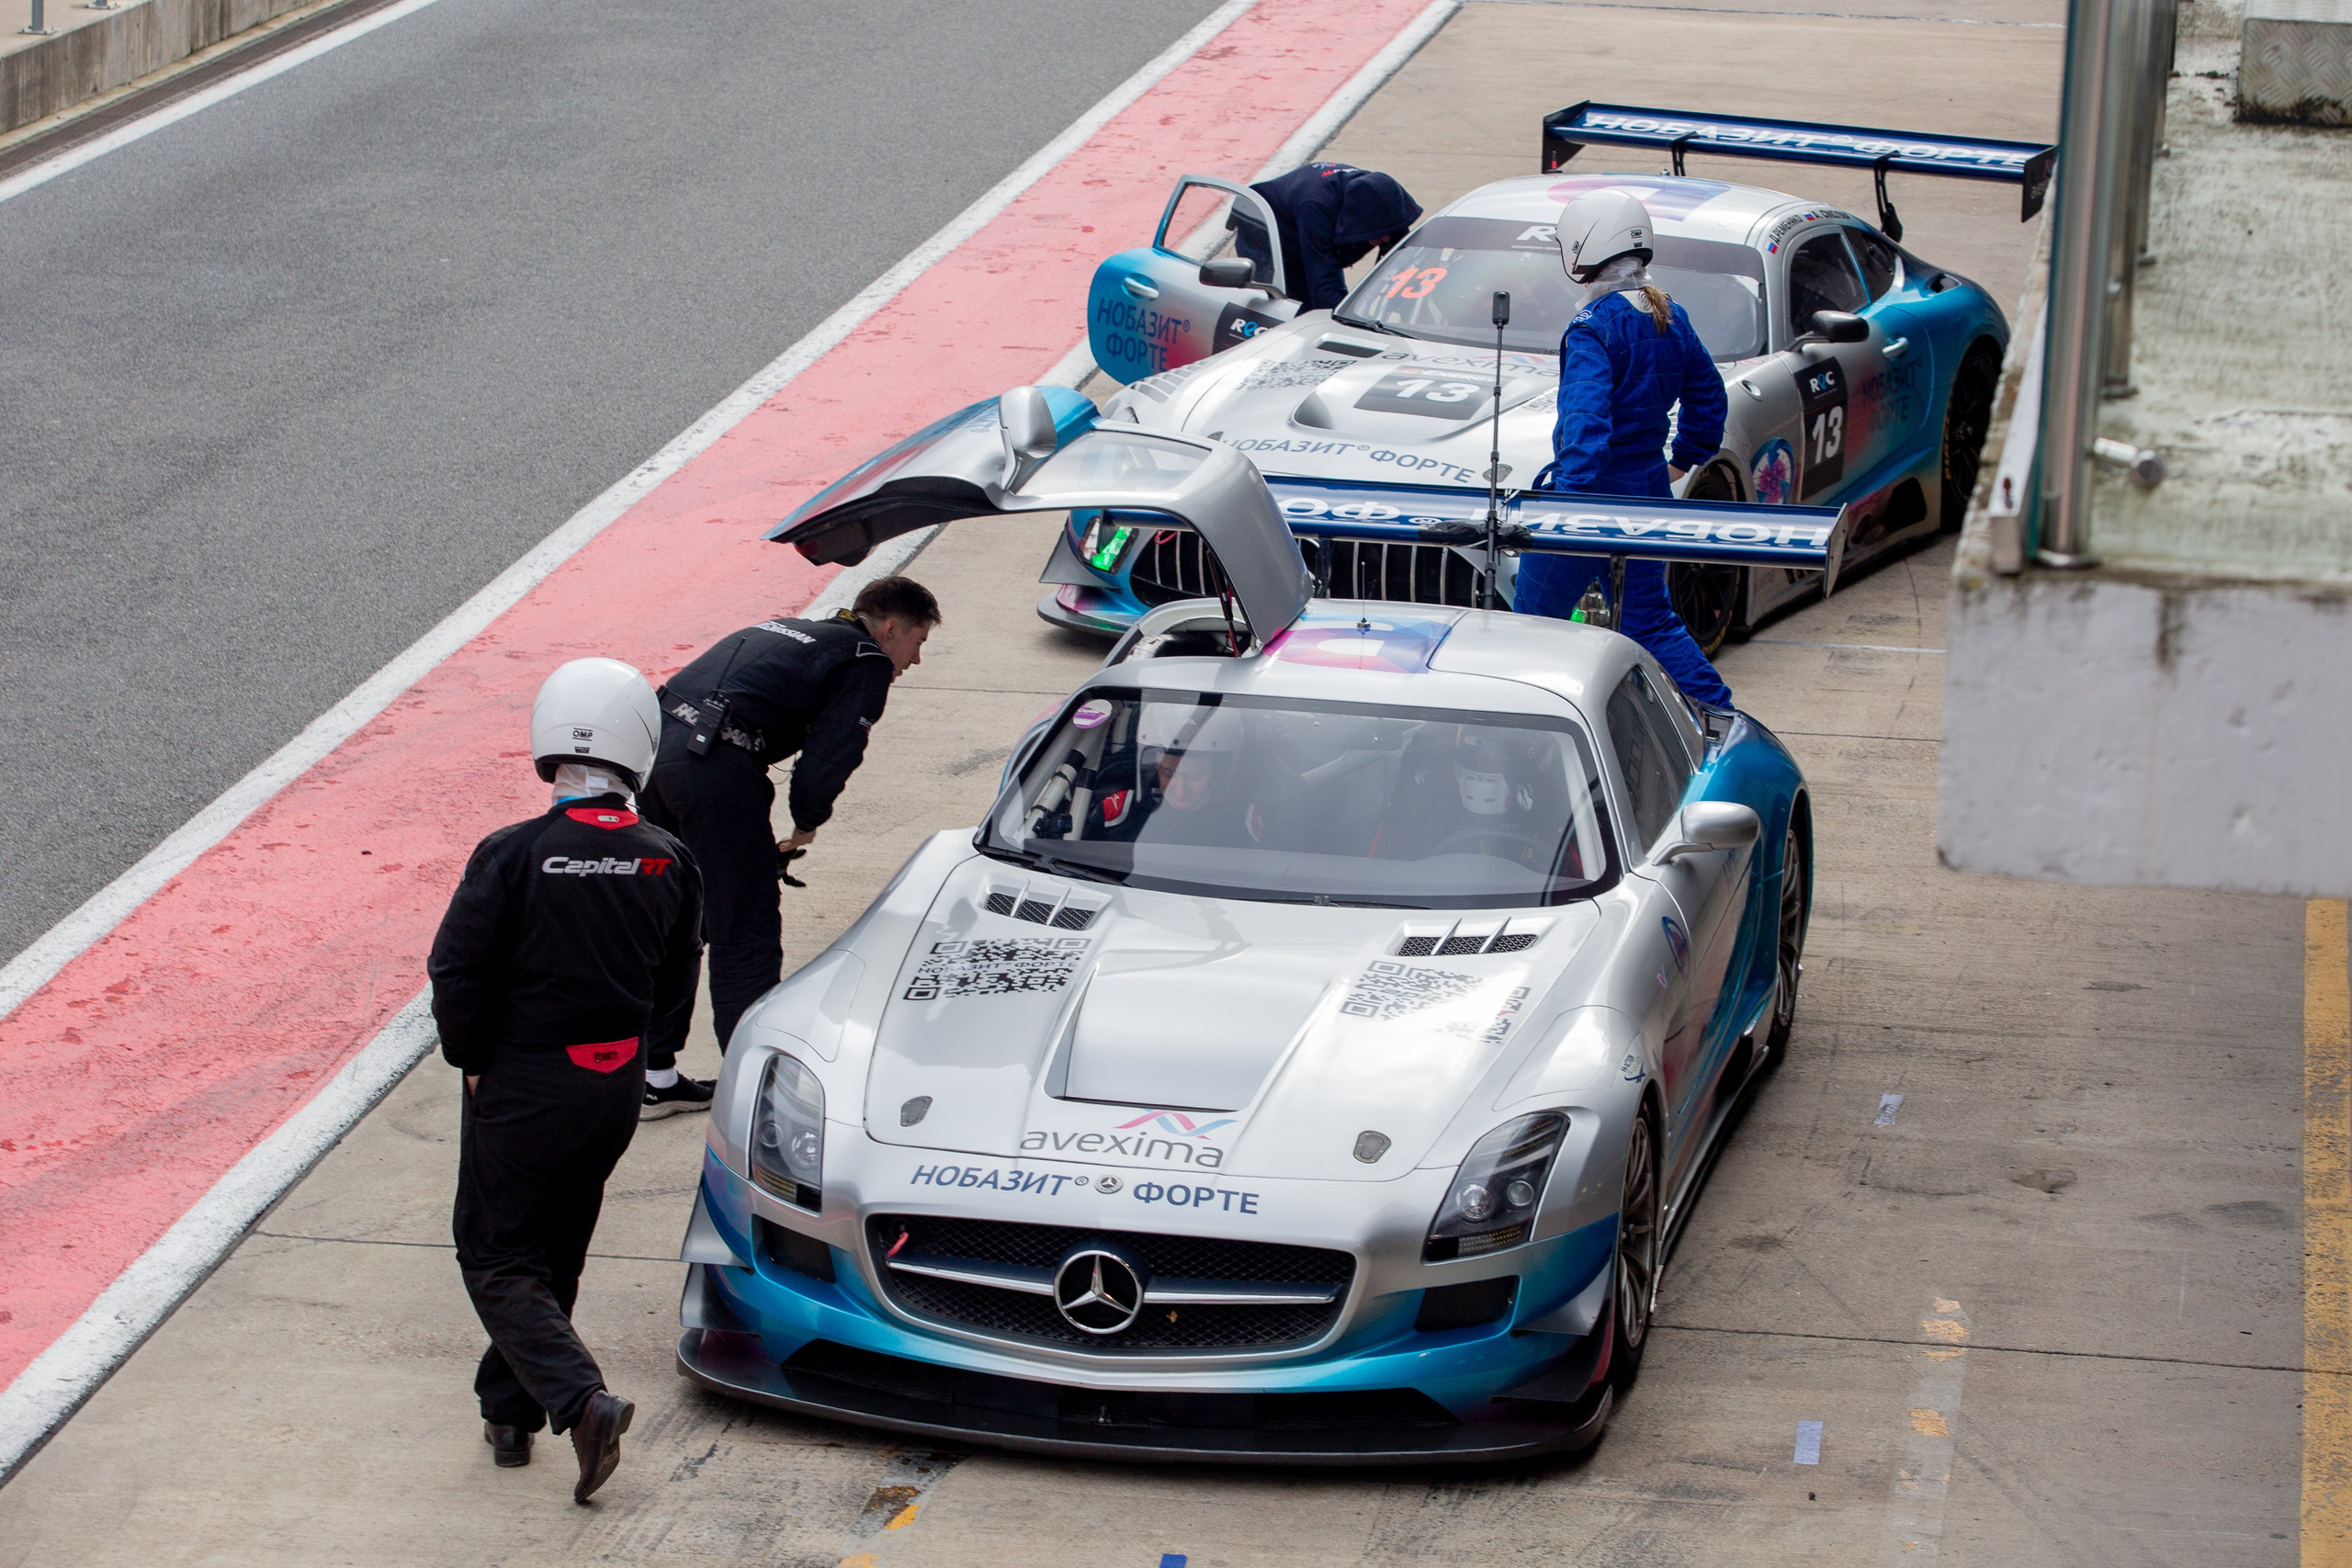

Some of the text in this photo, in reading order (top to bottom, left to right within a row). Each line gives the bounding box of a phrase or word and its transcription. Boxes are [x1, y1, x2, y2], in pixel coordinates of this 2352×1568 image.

[1385, 267, 1448, 299] 13
[1106, 332, 1169, 372] ФОРТЕ
[1381, 352, 1560, 378] avexima
[1396, 378, 1481, 402] 13
[1812, 406, 1843, 464] 13
[1370, 449, 1476, 483] ФОРТЕ
[572, 728, 594, 739] OMP
[1020, 1131, 1225, 1168] avexima
[910, 1165, 1260, 1215] НОБАЗИТ® ФОРТЕ
